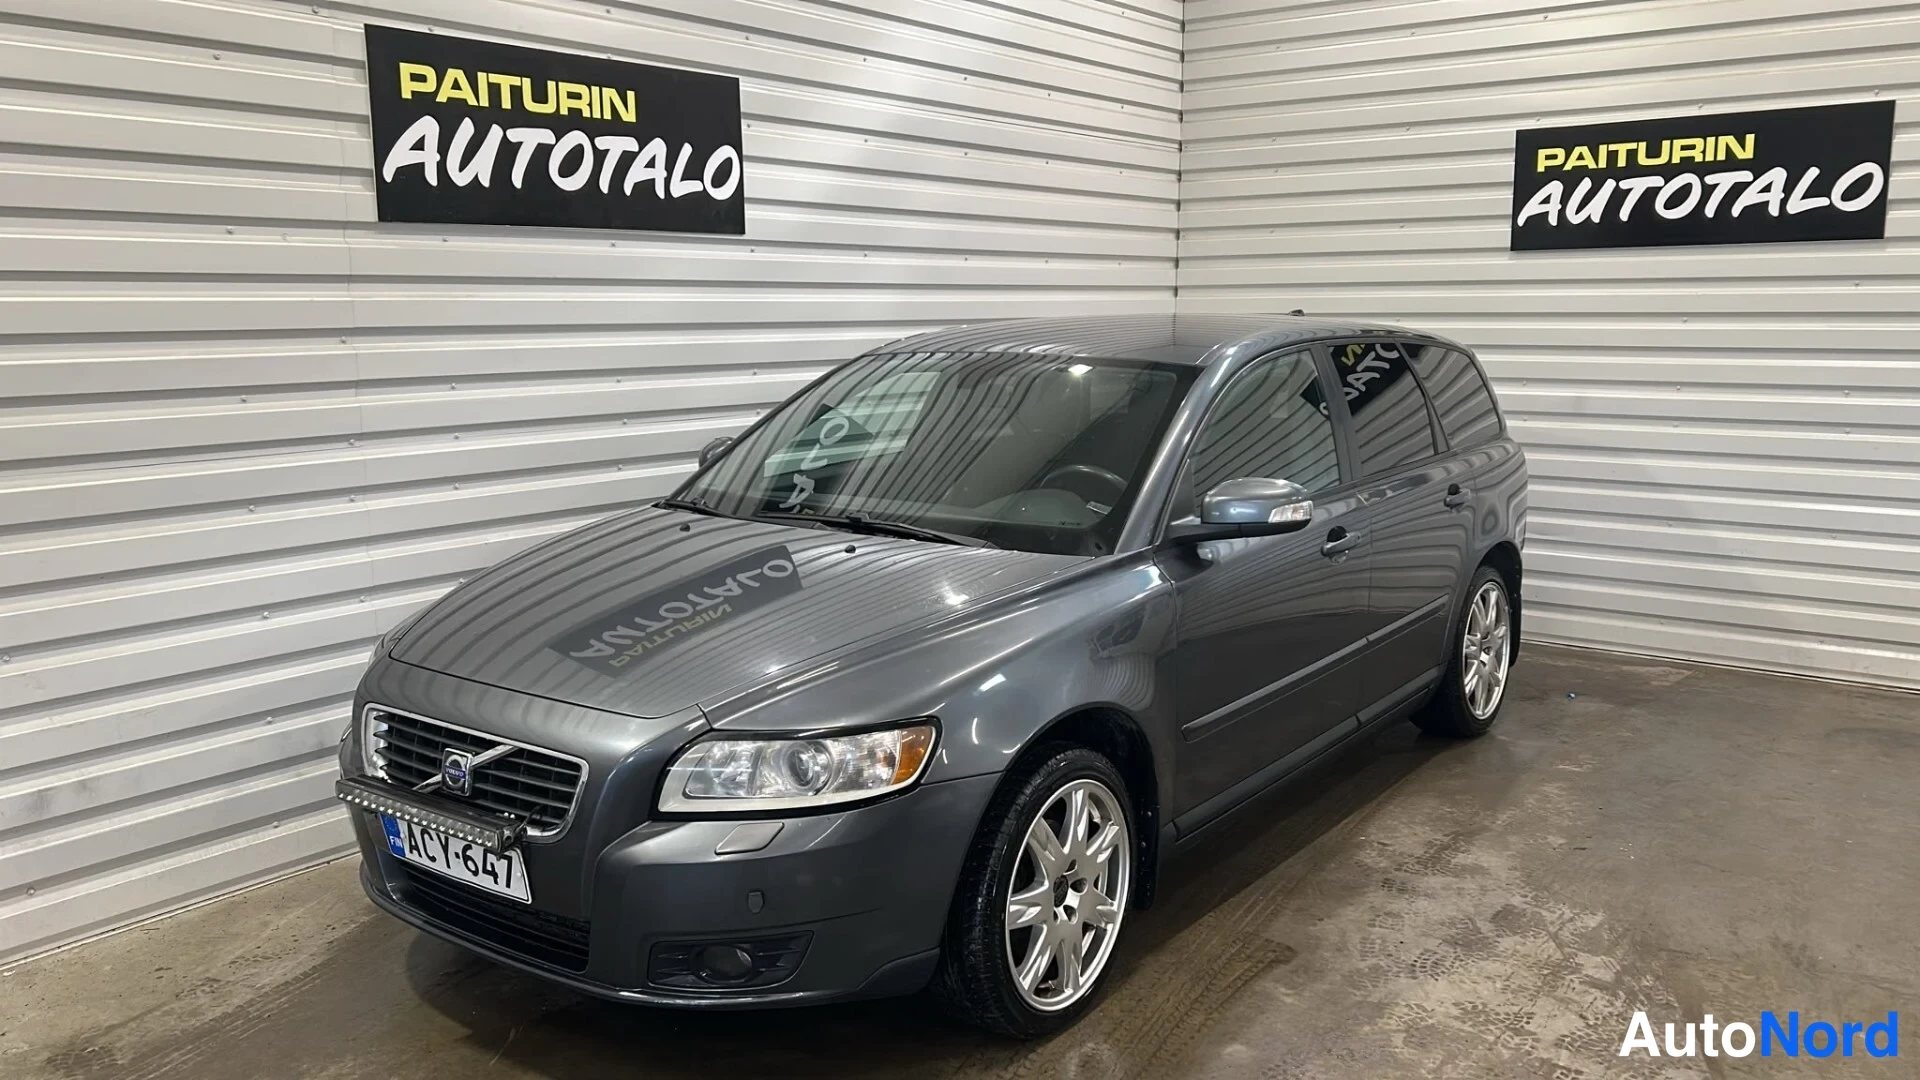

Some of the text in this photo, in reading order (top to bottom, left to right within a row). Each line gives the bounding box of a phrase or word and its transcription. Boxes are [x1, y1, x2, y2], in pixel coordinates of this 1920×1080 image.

[399, 62, 637, 123] PAITURIN
[382, 115, 741, 200] AUTOTALO
[1537, 133, 1756, 173] PAITURIN
[1516, 161, 1884, 227] AUTOTALO
[390, 836, 403, 848] FIN
[407, 822, 513, 889] ACY-647
